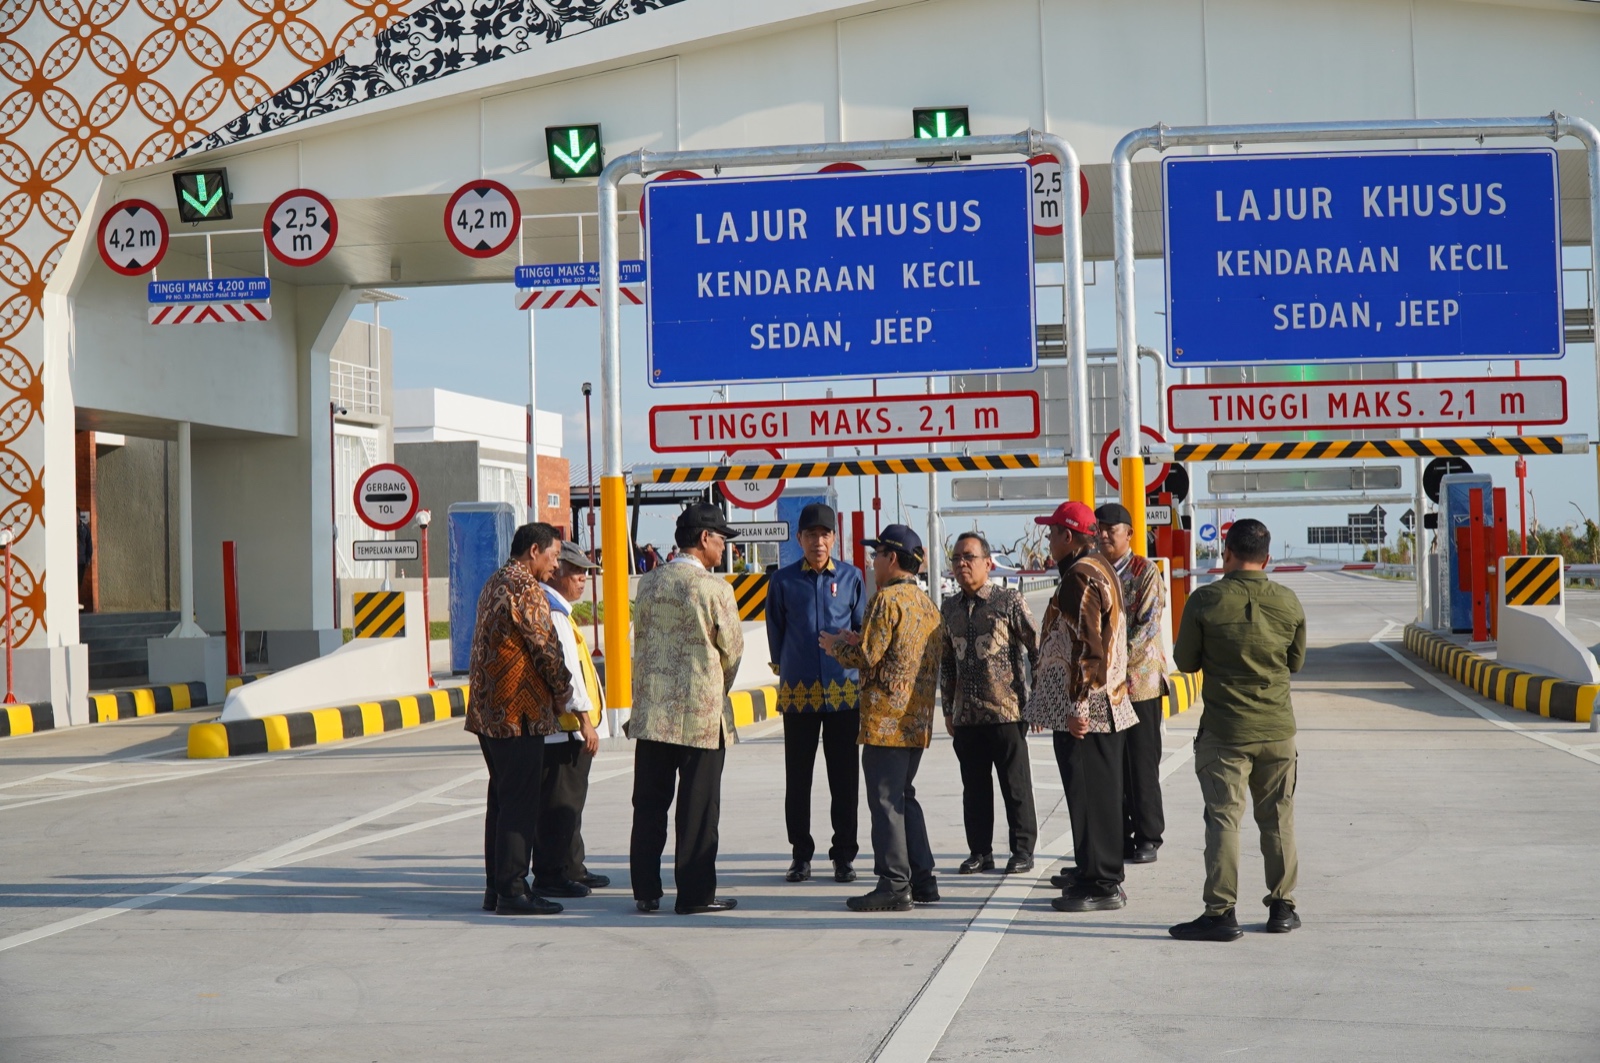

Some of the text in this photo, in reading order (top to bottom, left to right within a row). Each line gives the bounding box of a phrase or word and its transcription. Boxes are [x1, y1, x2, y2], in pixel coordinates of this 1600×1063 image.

[1034, 171, 1062, 197] 2,5
[1040, 199, 1058, 218] m
[1215, 182, 1508, 222] LAJUR KHUSUS
[285, 206, 318, 232] 2,5
[457, 208, 507, 233] 4,2 m
[695, 199, 983, 245] LAJUR KHUSUS
[109, 227, 156, 252] 4,2 m
[293, 233, 312, 251] m
[520, 267, 554, 278] TINGGI
[558, 265, 585, 277] MAKS
[622, 264, 641, 274] mm
[1216, 243, 1509, 277] KENDARAAN KECIL
[153, 280, 266, 294] TINGGI MAKS 4,200 mm
[697, 259, 981, 298] KENDARAAN KECIL
[1273, 299, 1460, 332] SEDAN, JEEP
[749, 316, 932, 352] SEDAN, JEEP
[1208, 388, 1526, 422] TINGGI MAKS. 2,1 m
[688, 404, 1000, 441] TINGGI MAKS. 2,1 m
[366, 482, 406, 492] GERBANG
[744, 482, 760, 492] TOL
[378, 504, 394, 514] TOL
[1146, 512, 1167, 520] KARTU
[765, 527, 785, 536] KARTU
[357, 544, 415, 555] TEMPELKAN KARTU
